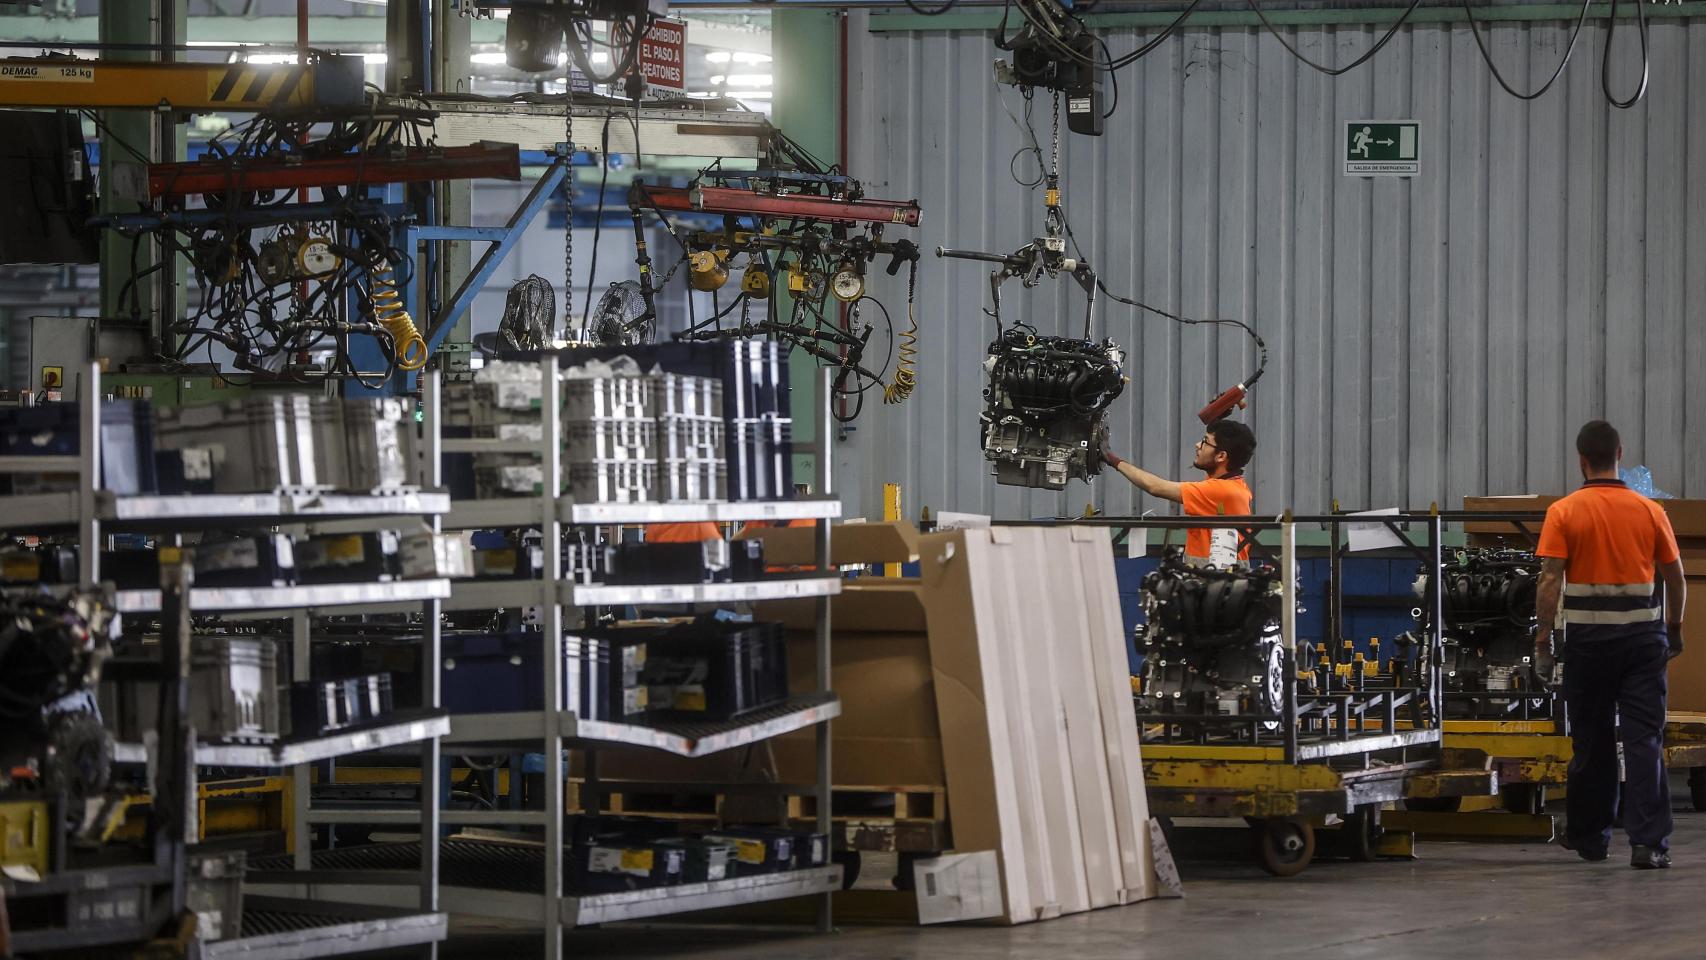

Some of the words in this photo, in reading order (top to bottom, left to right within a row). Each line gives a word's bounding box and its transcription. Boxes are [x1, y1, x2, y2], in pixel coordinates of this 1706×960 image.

[642, 43, 651, 58] EL
[653, 45, 673, 62] PASO
[674, 50, 680, 63] A
[1, 67, 38, 76] DEMAG
[61, 68, 77, 77] 125
[79, 67, 92, 79] kg
[642, 62, 680, 82] PEATONES
